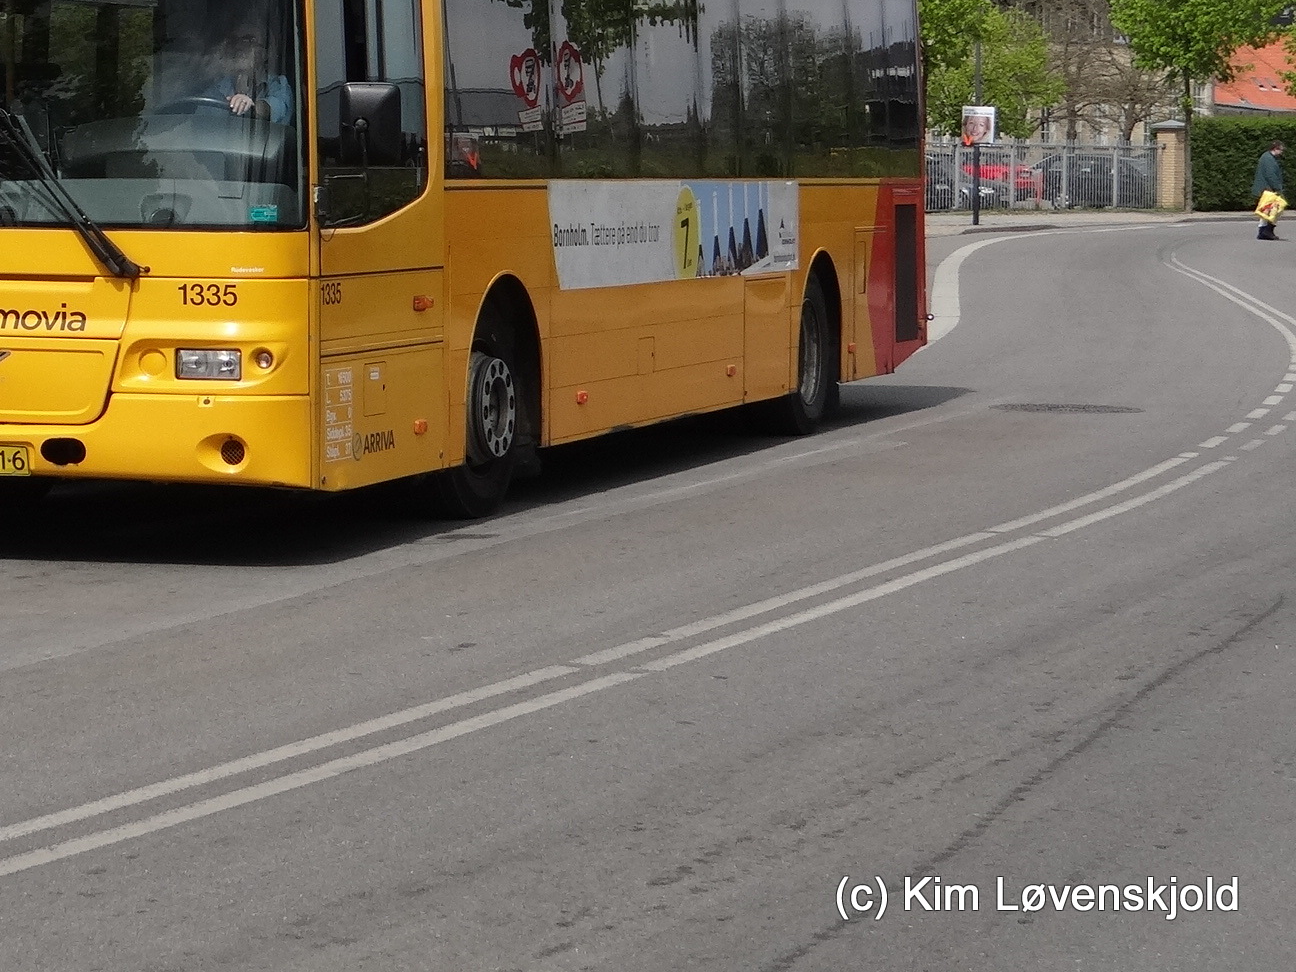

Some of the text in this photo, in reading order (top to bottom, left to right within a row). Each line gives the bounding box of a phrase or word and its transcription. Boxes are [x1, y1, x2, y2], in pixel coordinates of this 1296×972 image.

[554, 220, 661, 249] Bornholm. Tættere på end du tror
[680, 217, 689, 269] 7
[178, 283, 238, 307] 1335
[321, 282, 342, 306] 1335
[363, 429, 396, 455] ARRIVA
